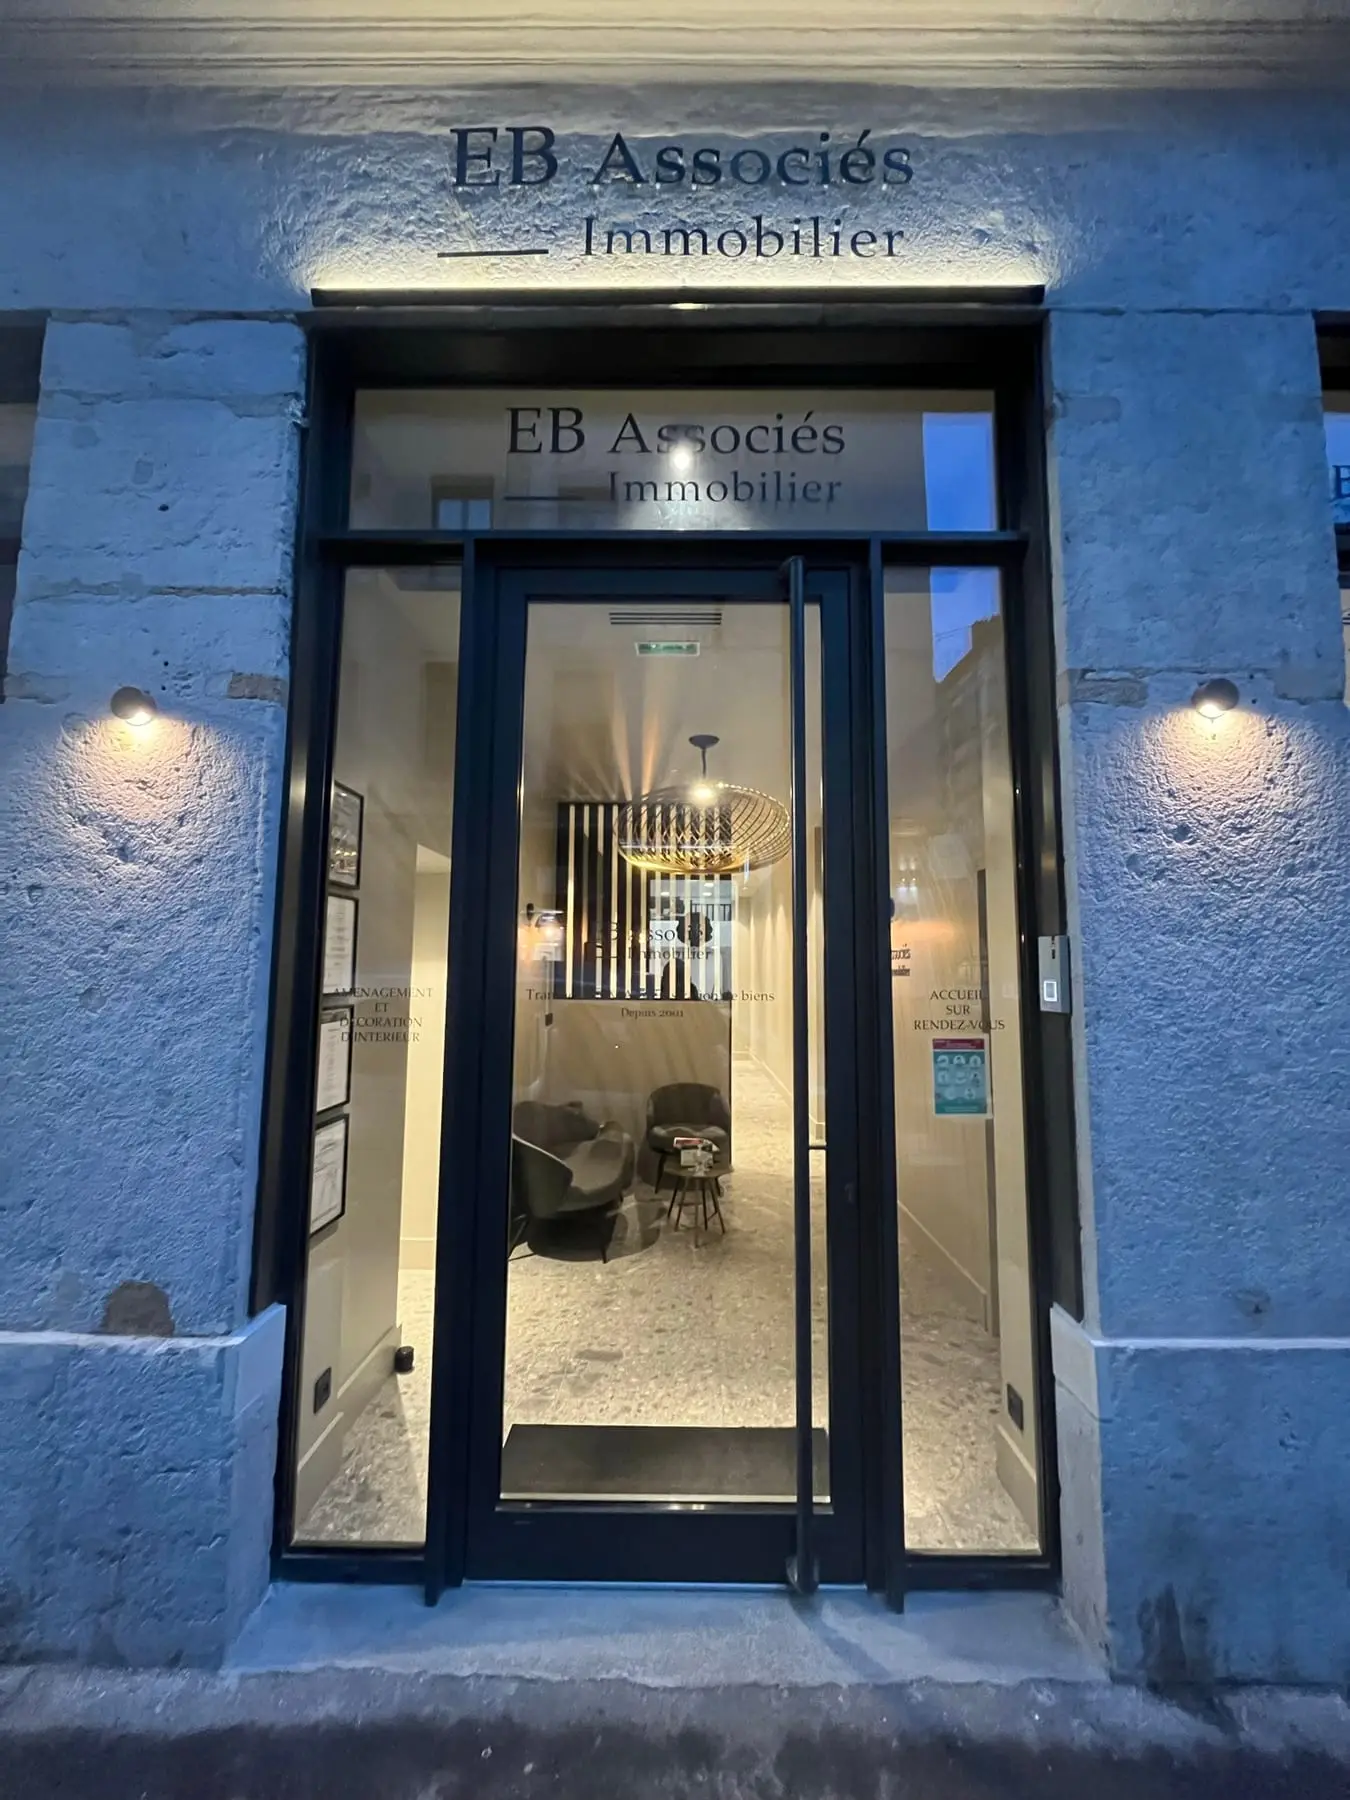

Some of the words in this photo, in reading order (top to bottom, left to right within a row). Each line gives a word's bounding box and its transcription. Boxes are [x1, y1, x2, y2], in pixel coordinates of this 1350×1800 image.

[449, 126, 559, 188] EB
[588, 129, 915, 187] Associés
[580, 215, 905, 258] Immobilier
[506, 407, 586, 455] EB
[607, 411, 845, 455] Associés
[609, 471, 843, 504] Immobilier
[375, 1002, 389, 1013] ET
[945, 1004, 970, 1015] SUR
[914, 1020, 1005, 1031] RENDEZ-VOUS
